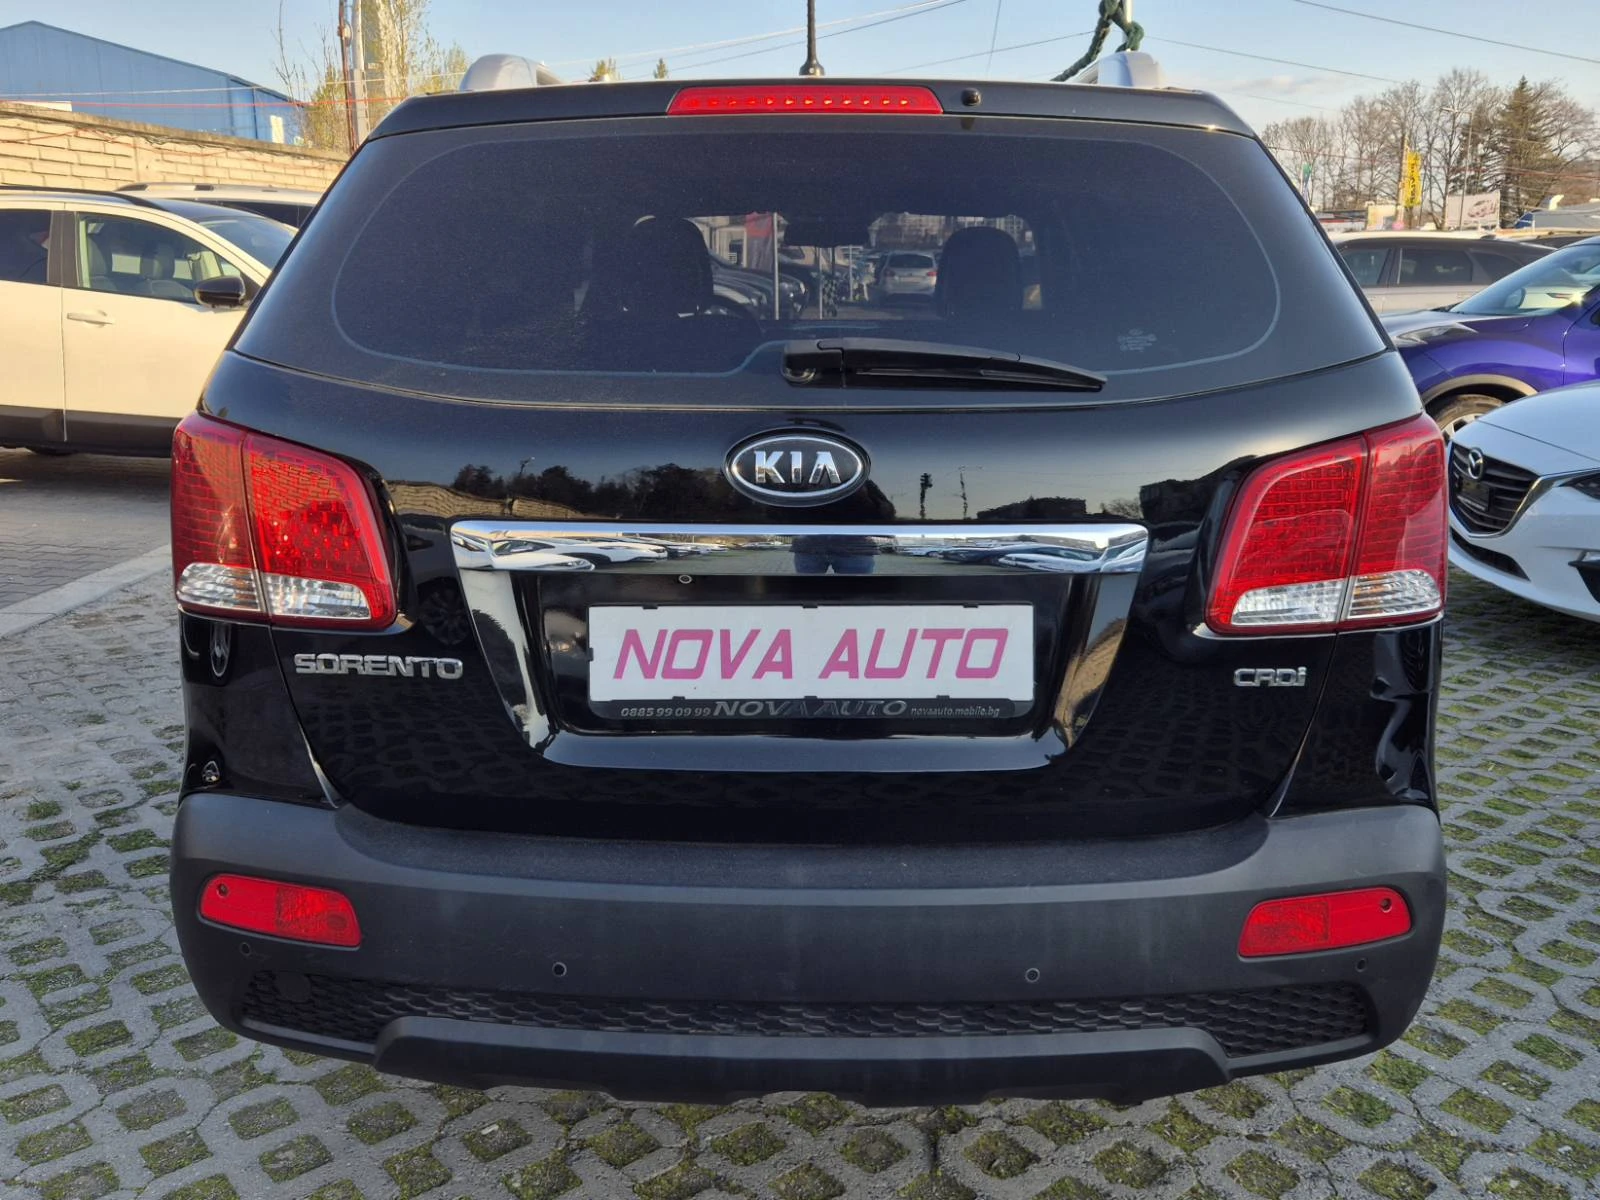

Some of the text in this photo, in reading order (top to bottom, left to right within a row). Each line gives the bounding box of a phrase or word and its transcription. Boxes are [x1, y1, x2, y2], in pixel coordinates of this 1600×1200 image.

[754, 450, 842, 484] KIA
[293, 653, 464, 680] SORENTO
[613, 628, 1009, 680] NOVA AUTO
[1233, 666, 1307, 687] CRDi
[620, 700, 1000, 717] 0885 99 09 99 NOVA AUTO novaauto.mobile.bg
